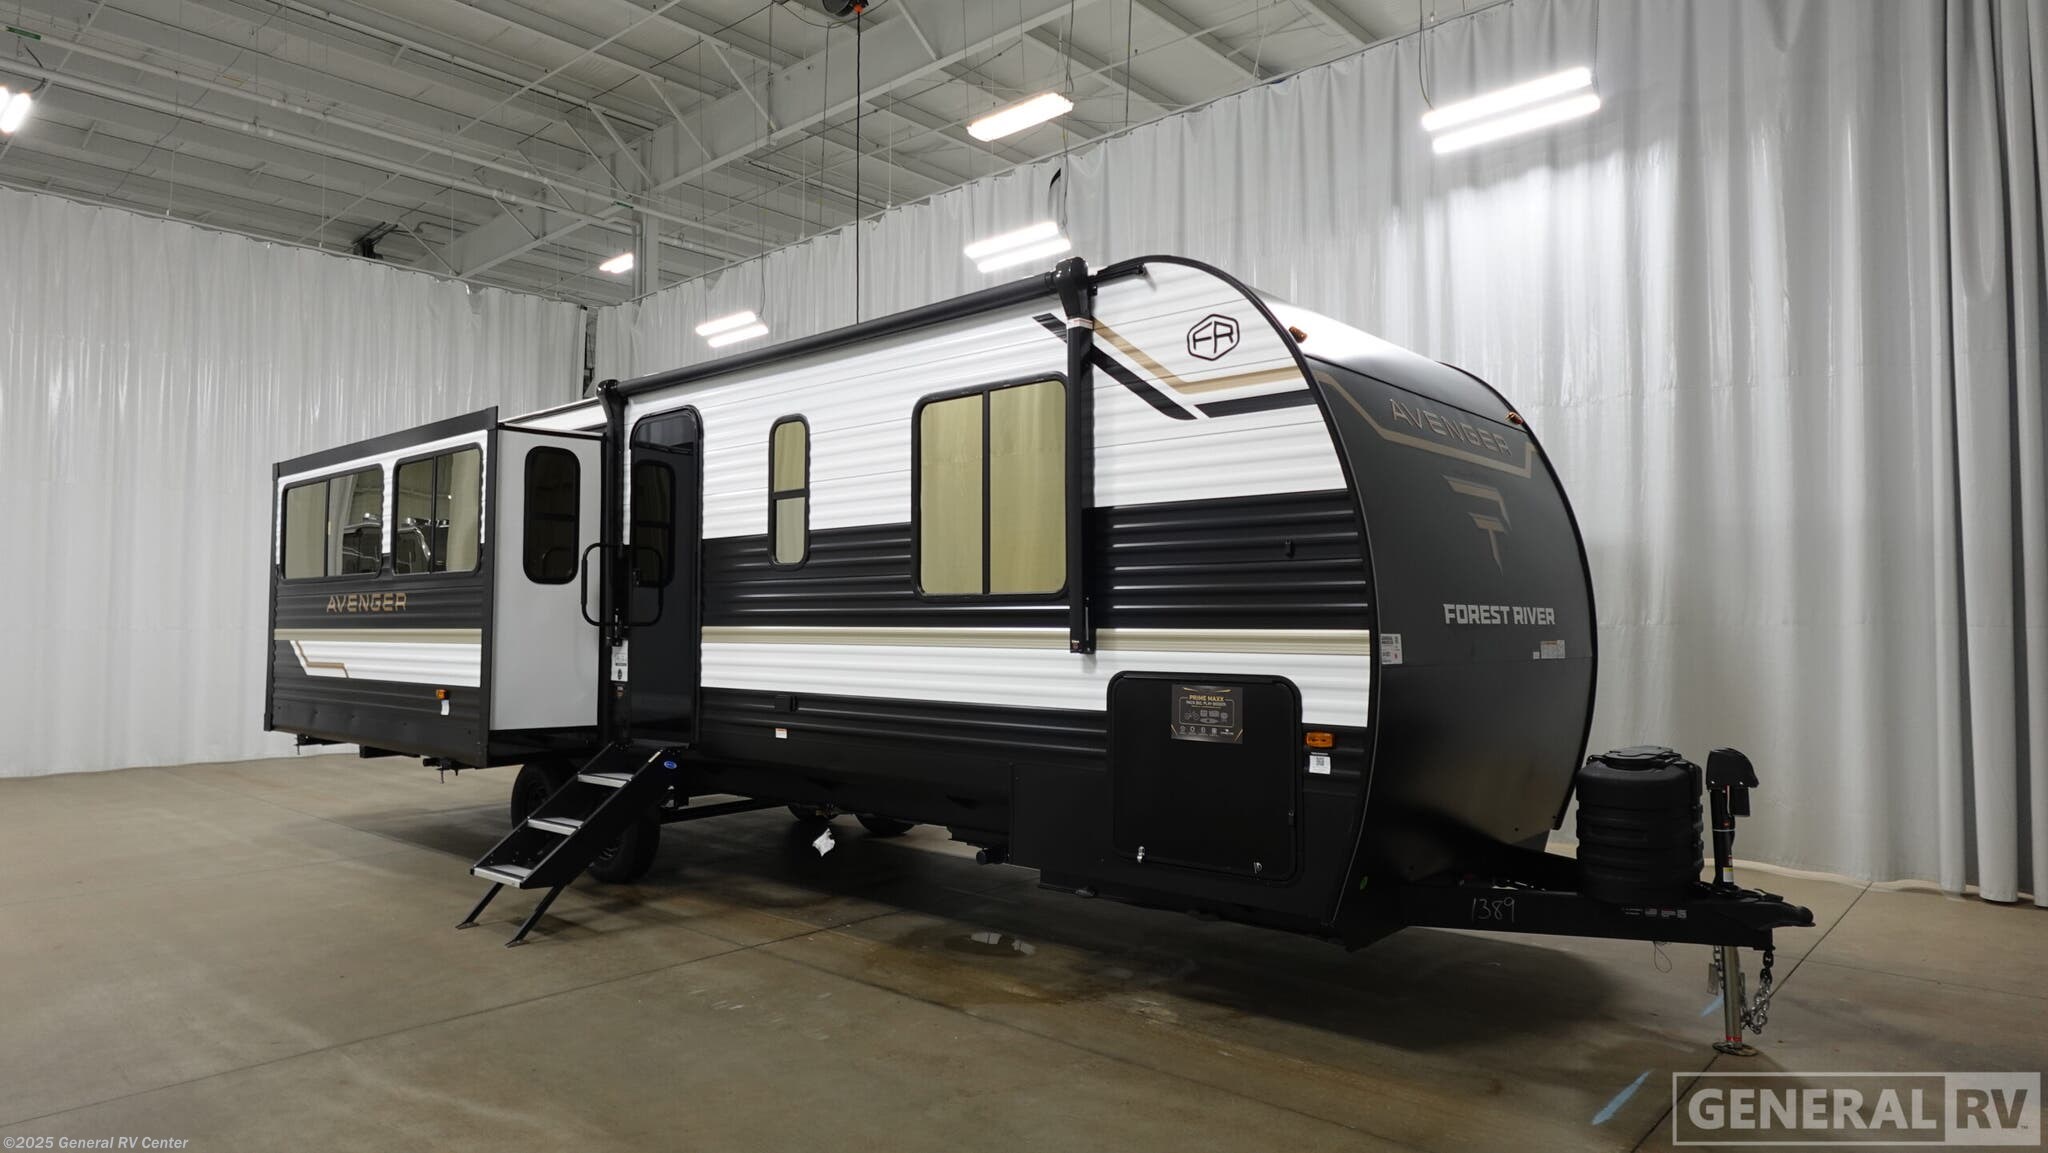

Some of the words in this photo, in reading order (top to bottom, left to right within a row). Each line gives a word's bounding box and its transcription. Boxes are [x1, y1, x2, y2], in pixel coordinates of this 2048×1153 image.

[1390, 399, 1512, 457] AVENGER
[326, 592, 408, 613] AVENGER
[1443, 603, 1510, 625] FOREST
[1512, 606, 1556, 625] RIVER
[1472, 896, 1515, 923] 1389
